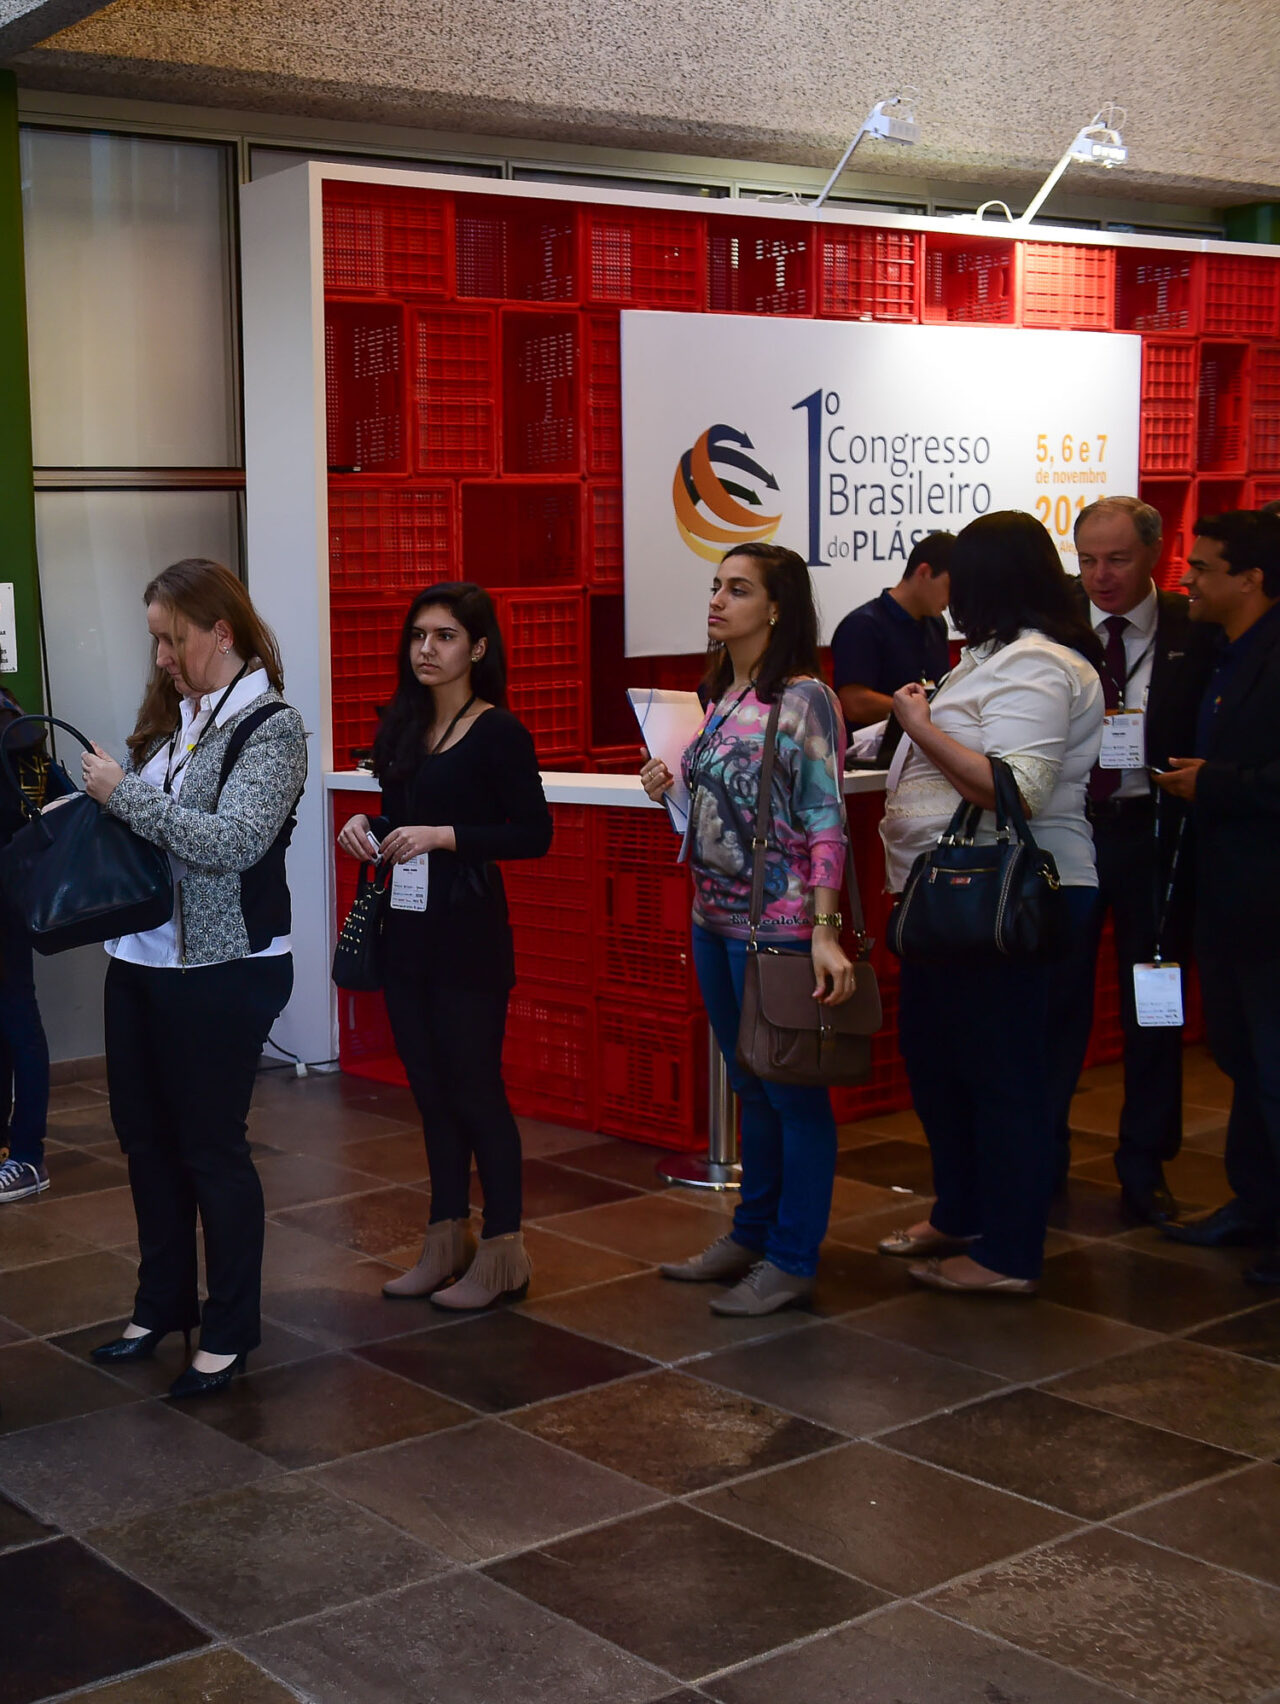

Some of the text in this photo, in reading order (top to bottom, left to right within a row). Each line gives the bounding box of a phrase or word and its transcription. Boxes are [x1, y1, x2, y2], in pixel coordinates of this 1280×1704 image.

[827, 425, 991, 478] Congresso
[1035, 433, 1108, 468] 5, 6 e 7
[1035, 467, 1108, 484] de novembro
[828, 470, 992, 517] Brasileiro
[827, 534, 850, 559] do
